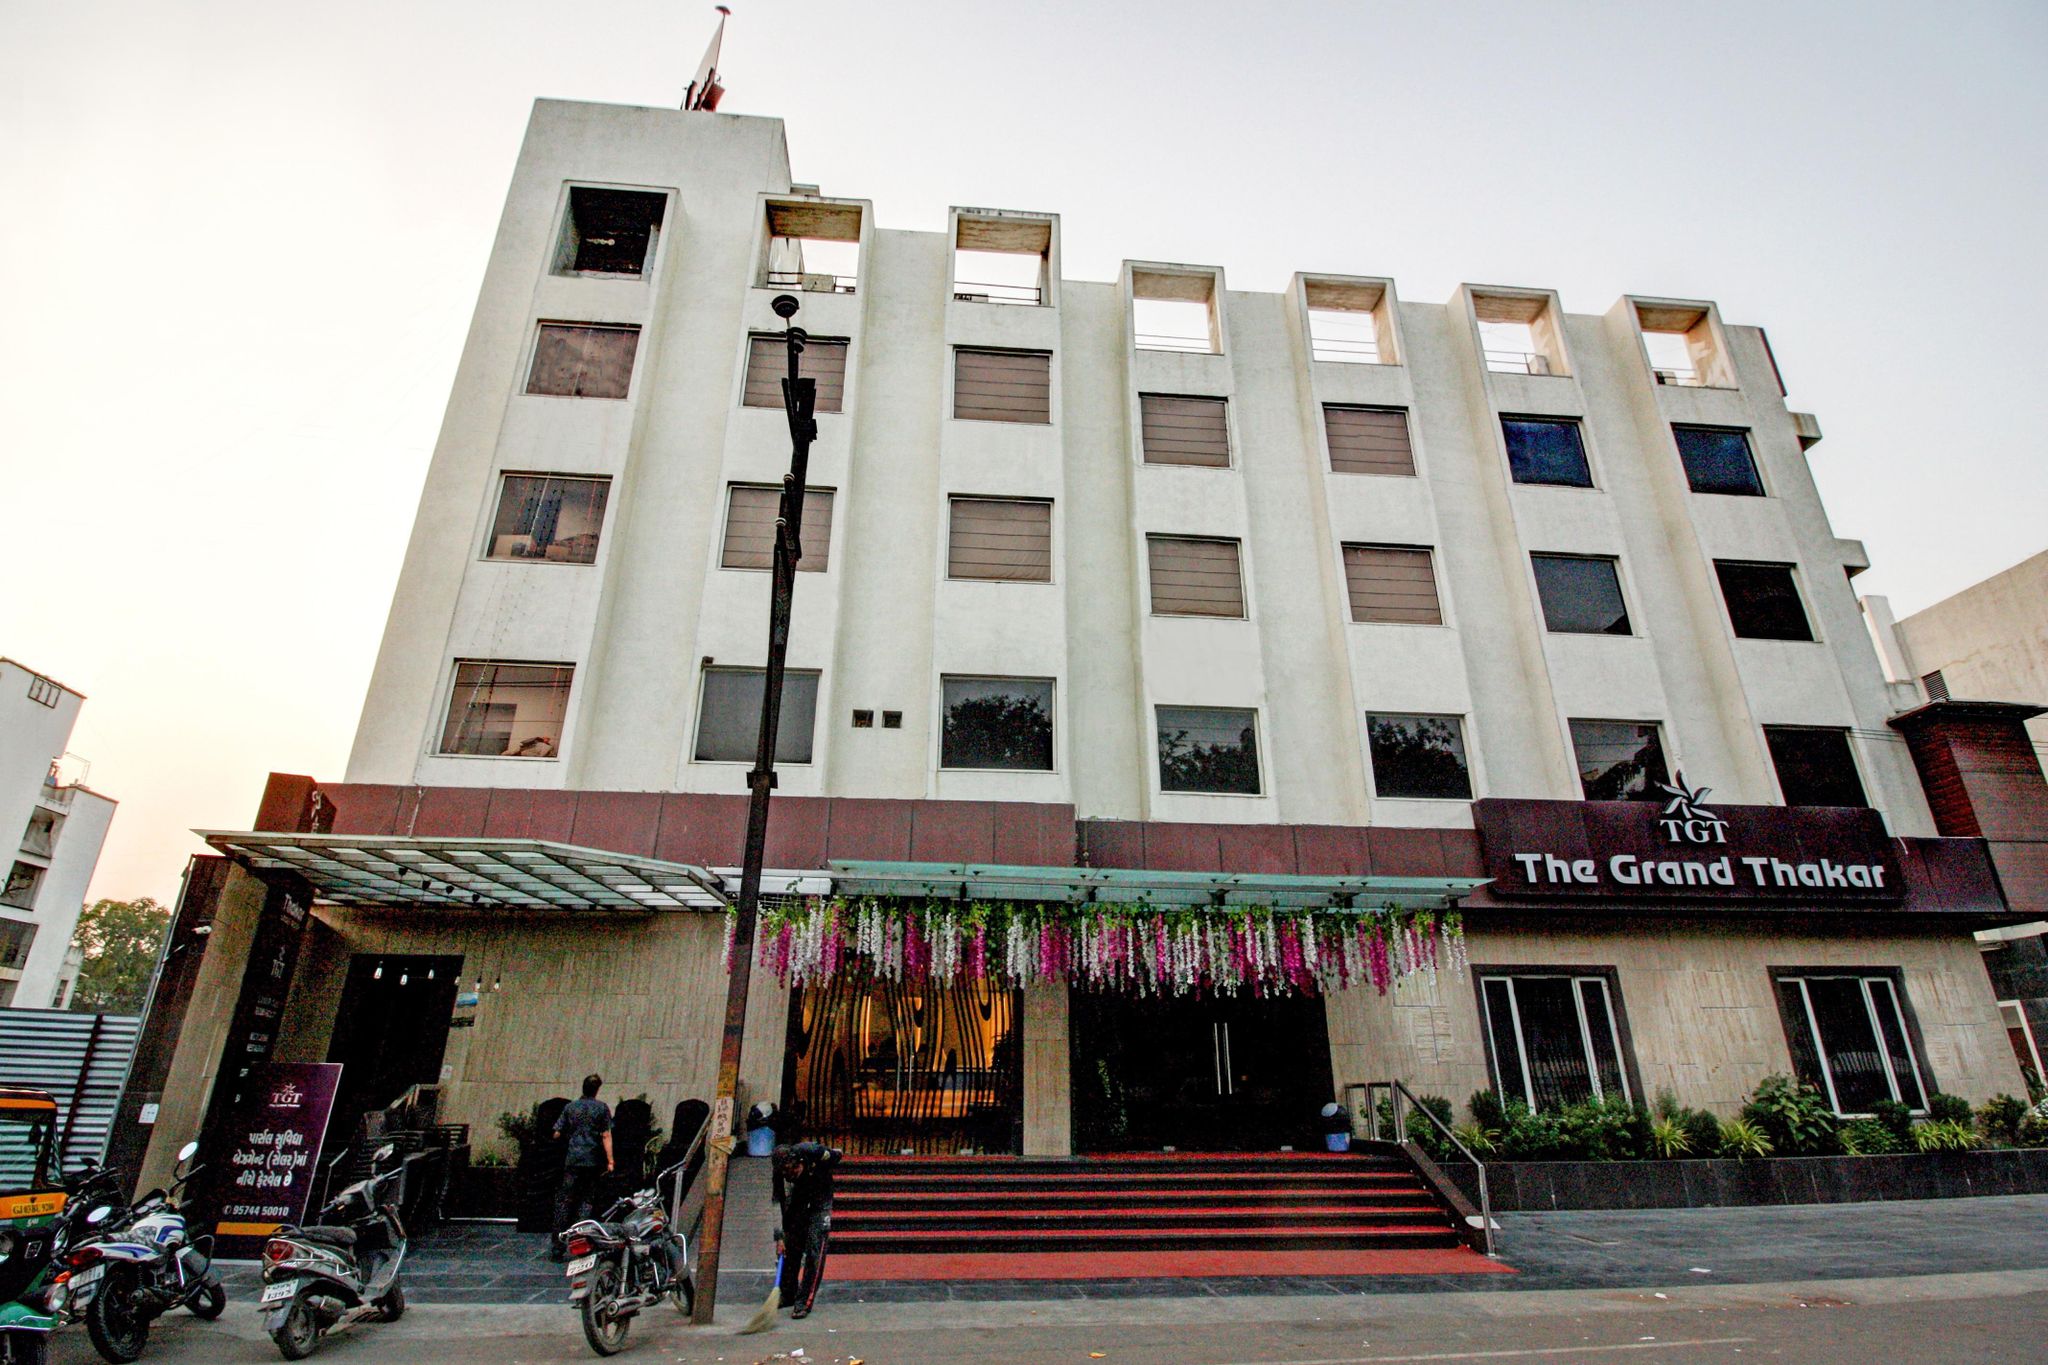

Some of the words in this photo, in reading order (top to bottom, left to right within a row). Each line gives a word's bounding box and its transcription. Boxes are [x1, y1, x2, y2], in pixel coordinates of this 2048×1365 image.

[1660, 819, 1730, 843] TGT
[1514, 853, 1599, 883] The
[1609, 854, 1735, 885] Grand
[1741, 857, 1885, 888] Thakar
[272, 1093, 303, 1104] TGT
[232, 1205, 261, 1216] 95744
[261, 1206, 290, 1217] 50010
